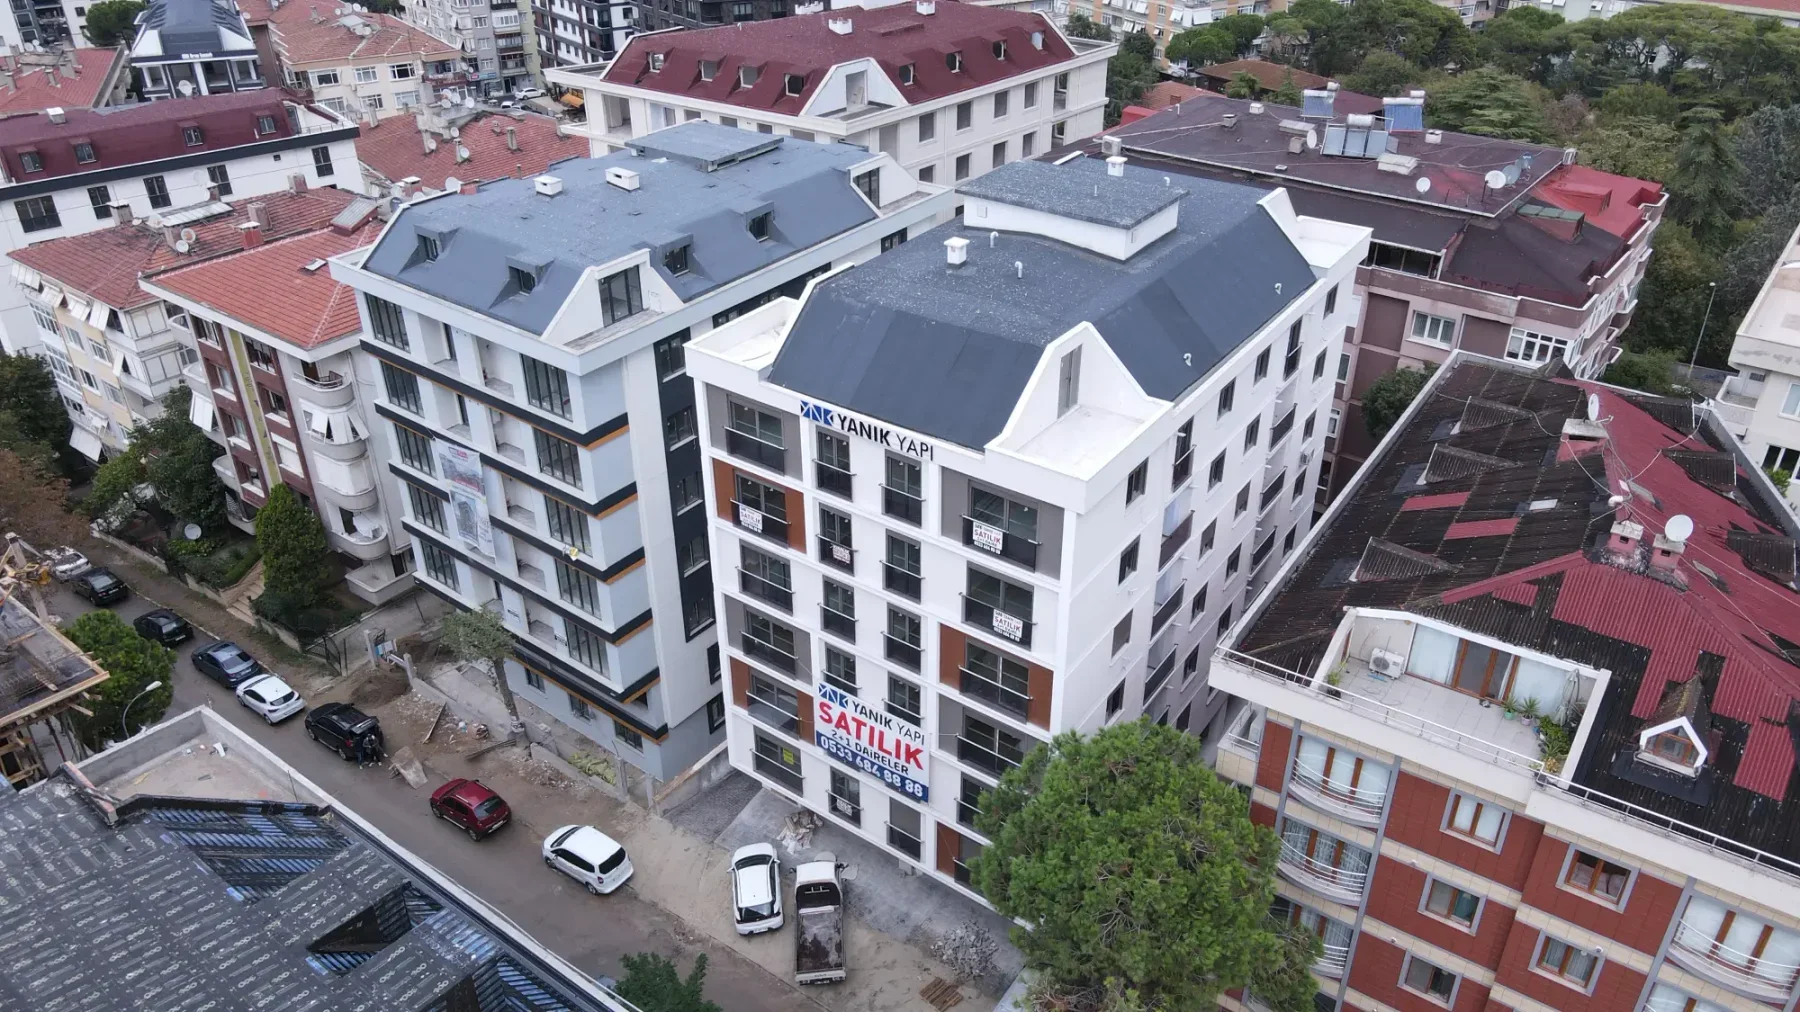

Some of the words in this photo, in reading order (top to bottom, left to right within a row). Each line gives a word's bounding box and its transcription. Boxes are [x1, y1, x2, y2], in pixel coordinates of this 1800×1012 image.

[837, 413, 891, 447] YANIK
[896, 433, 934, 461] YAPI
[974, 529, 1001, 544] SATILIK
[994, 616, 1021, 632] SATILIK
[819, 701, 923, 770] SATILIK
[831, 729, 852, 748] 2+1
[853, 701, 892, 730] YANIK
[896, 721, 925, 746] YAPI
[821, 736, 853, 762] 0533
[855, 756, 881, 778] 684
[884, 769, 902, 787] 88
[905, 779, 923, 797] 88
